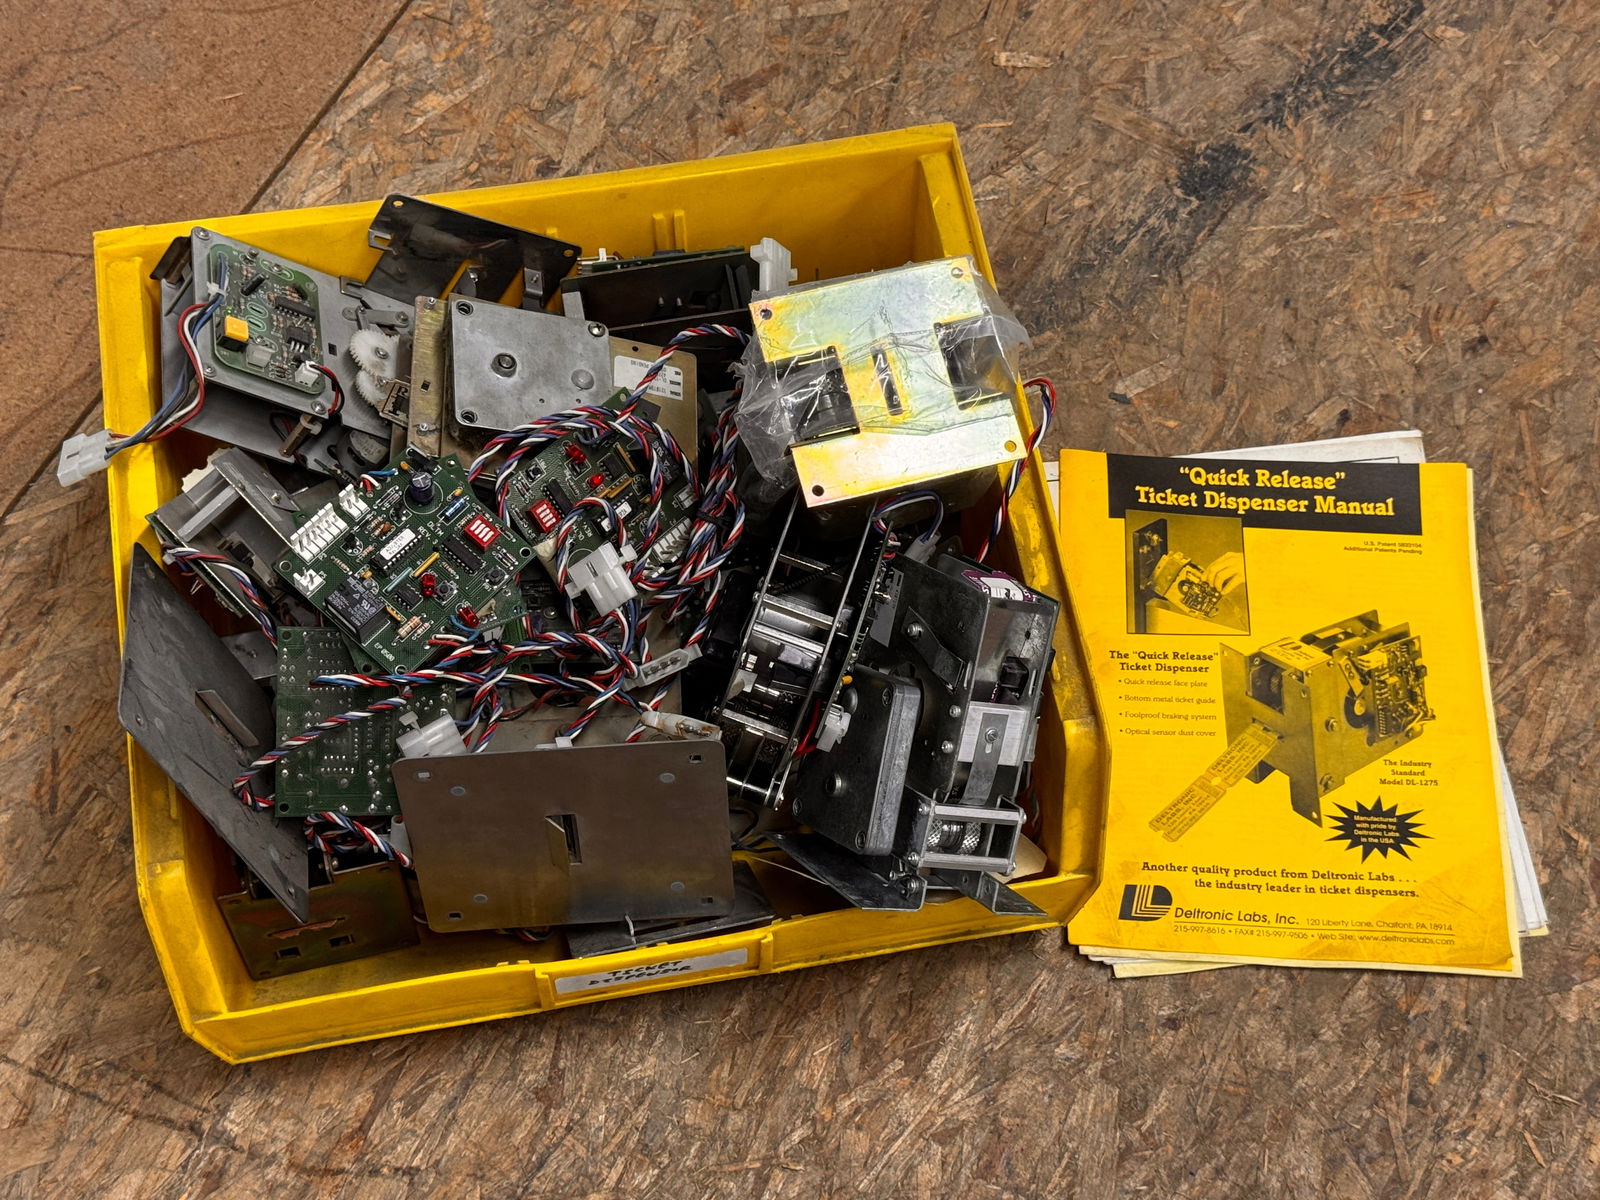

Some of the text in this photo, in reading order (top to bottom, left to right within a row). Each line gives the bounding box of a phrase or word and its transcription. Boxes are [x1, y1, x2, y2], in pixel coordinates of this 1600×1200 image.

[1180, 466, 1346, 490] “Quick Release”
[1135, 486, 1394, 516] Ticket Dispenser Manual
[1109, 650, 1129, 659] The
[1119, 662, 1209, 674] Ticket Dispenser
[1124, 711, 1160, 720] Foolproof
[1162, 712, 1188, 720] braking
[1125, 728, 1150, 736] Optical
[1400, 760, 1432, 768] Industry
[1142, 862, 1395, 882] Another quality product from Deltronic Labs
[1195, 879, 1419, 898] the industry leader in ticket dispensers.
[1174, 908, 1233, 921] Deltronic
[1238, 910, 1271, 924] Labs,
[1275, 913, 1299, 925] Inc.
[1306, 918, 1320, 926] 120
[1322, 919, 1349, 928] Liberty
[1351, 920, 1373, 928] Lane,
[1376, 920, 1413, 930] Chalfont,
[1430, 922, 1453, 931] 18914
[1174, 925, 1226, 935] 215-997-8616
[1318, 932, 1338, 941] Web
[1358, 934, 1455, 945] www.deltroniclabs.com
[607, 960, 682, 977] TICKET
